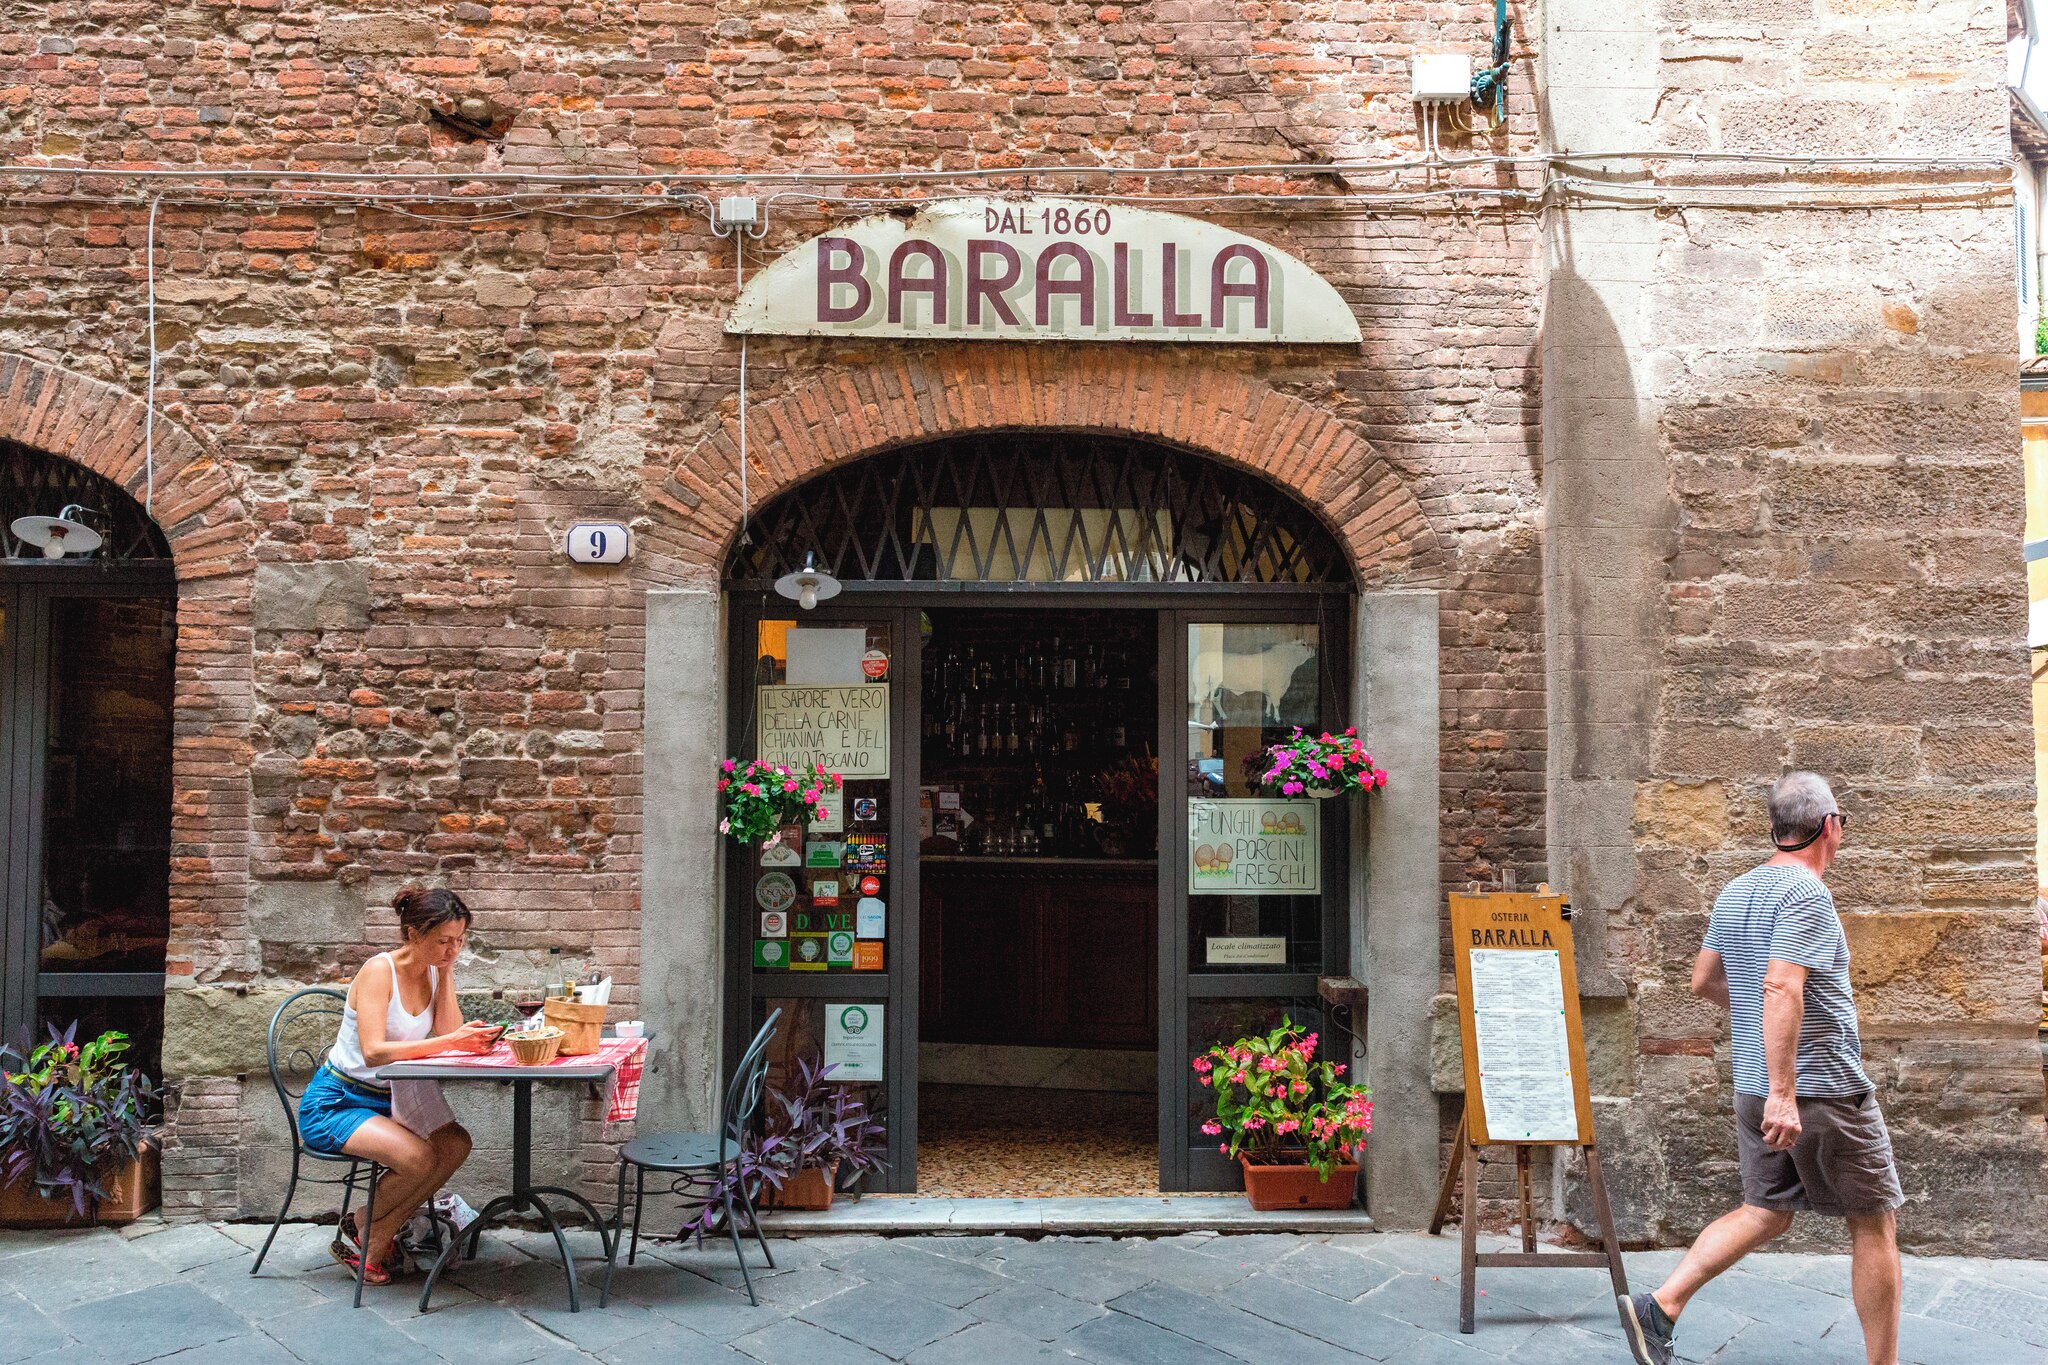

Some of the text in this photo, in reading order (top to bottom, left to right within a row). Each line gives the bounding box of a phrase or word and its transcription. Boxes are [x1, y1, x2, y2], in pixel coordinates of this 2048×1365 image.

[985, 207, 1111, 235] DAL 1860
[816, 237, 1268, 328] BARALLA
[590, 530, 607, 559] 9
[764, 692, 777, 709] IL
[839, 690, 883, 709] VERO
[764, 710, 870, 730] DELLA CARNE
[764, 730, 884, 749] CHIANINA E DEL
[813, 750, 869, 769] TOSCANO
[1197, 809, 1255, 836] FUNGHI
[1236, 838, 1305, 862] PORCINI
[1235, 863, 1306, 885] FRESCHI
[1491, 912, 1529, 922] OSTERIA
[1237, 942, 1281, 950] climatizzato
[1471, 928, 1554, 946] BARALLA
